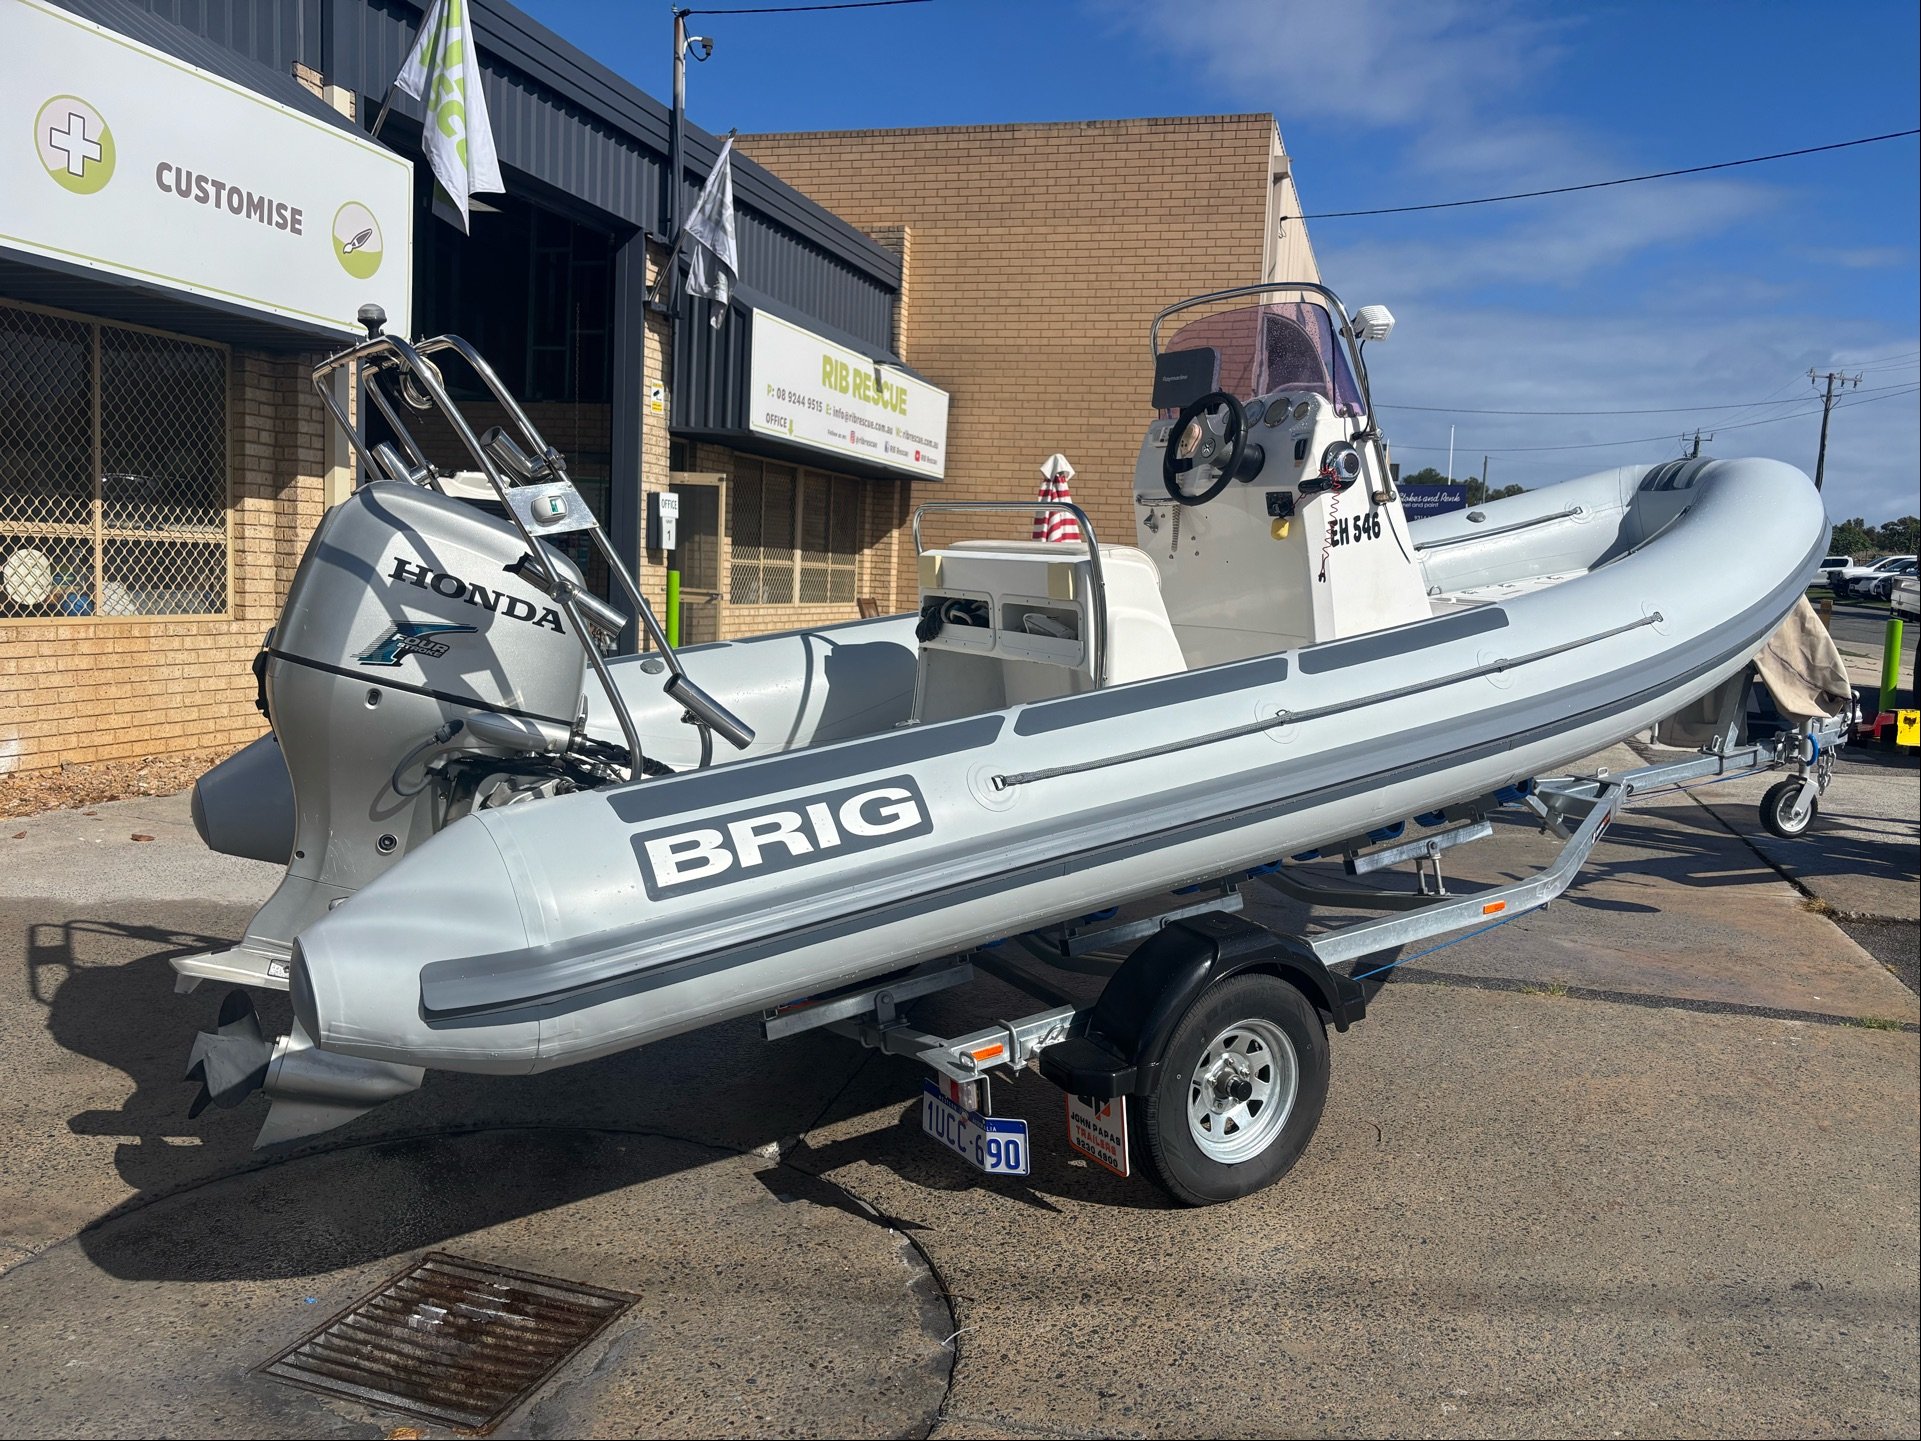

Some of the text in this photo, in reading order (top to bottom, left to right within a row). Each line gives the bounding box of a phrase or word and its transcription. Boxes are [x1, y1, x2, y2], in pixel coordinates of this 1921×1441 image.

[156, 161, 303, 236] CUSTOMISE
[821, 354, 908, 416] RIB RESCUE
[765, 412, 788, 428] OFFICE
[767, 383, 775, 398] P:
[776, 387, 786, 401] 08
[788, 391, 806, 408] 9244
[807, 397, 823, 413] 9515
[833, 406, 893, 435] info@ribrescue.com.au
[661, 499, 677, 510] OFFICE
[1422, 492, 1440, 502] and
[667, 530, 671, 541] 1
[1353, 511, 1381, 543] 546
[388, 556, 566, 635] HONDA
[391, 633, 449, 653] FOUR
[396, 642, 443, 657] STROKE
[644, 787, 922, 888] BRIG
[1071, 1111, 1121, 1147] JOHN PAPAS
[1075, 1124, 1117, 1157] TRAILERS
